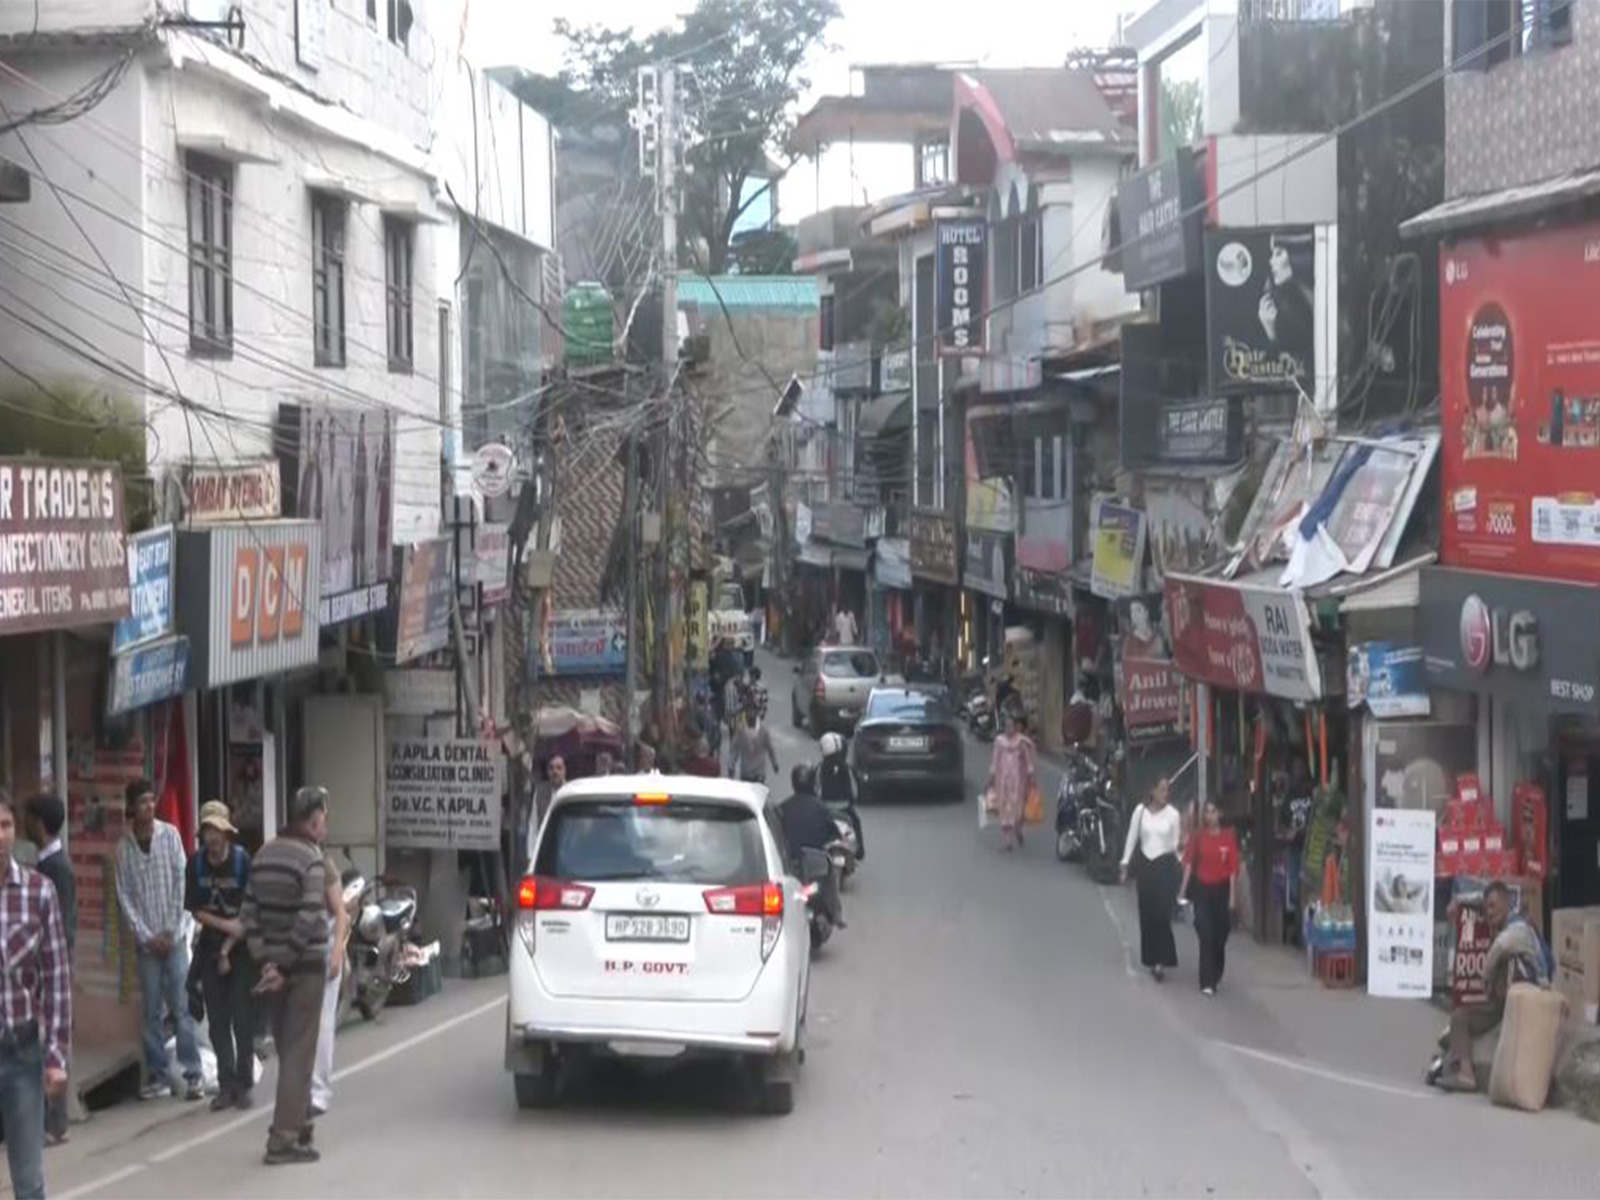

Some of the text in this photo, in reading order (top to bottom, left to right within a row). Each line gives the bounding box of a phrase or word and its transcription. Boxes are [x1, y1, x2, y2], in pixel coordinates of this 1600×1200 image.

[952, 245, 970, 347] ROOMS
[21, 467, 114, 520] TRADERS
[236, 555, 304, 621] DCM
[1264, 604, 1290, 638] RAI
[1492, 610, 1541, 669] LG
[393, 743, 490, 763] KAPILA DENTAL
[458, 765, 495, 783] CLINIC
[437, 797, 488, 817] KAPILA
[642, 961, 690, 975] GOVT.
